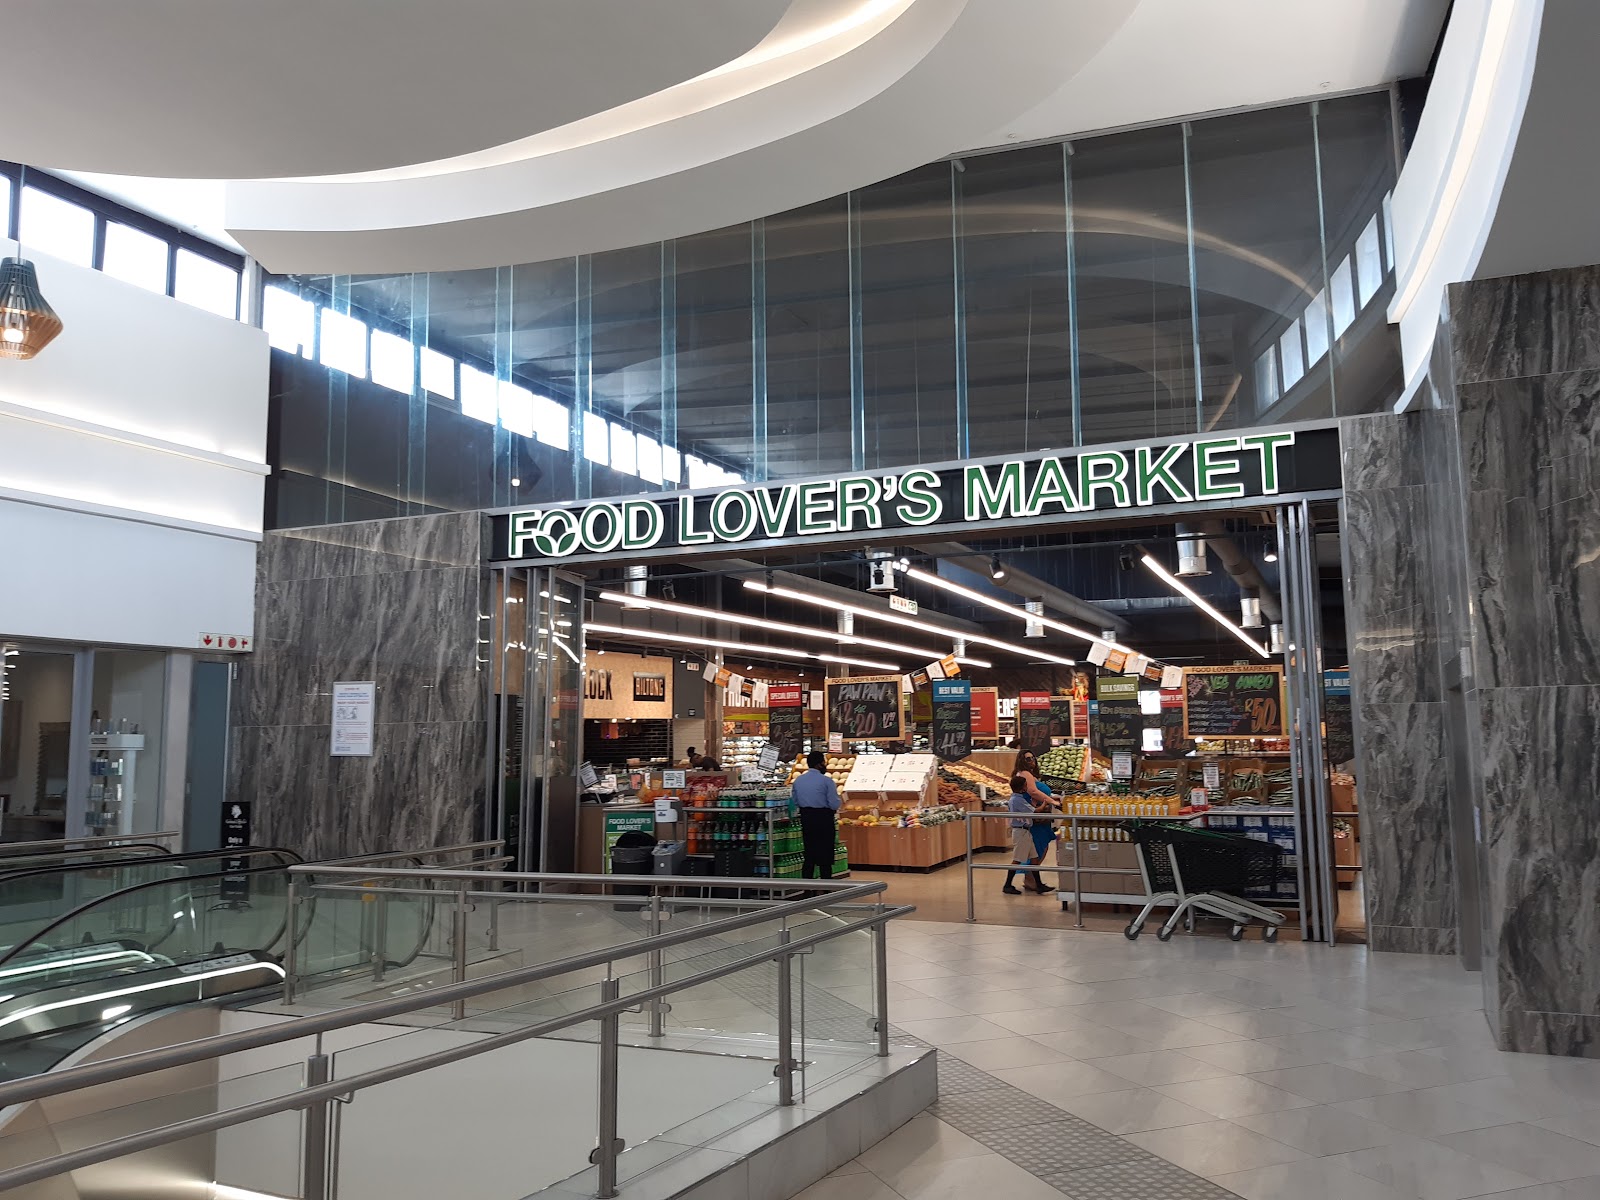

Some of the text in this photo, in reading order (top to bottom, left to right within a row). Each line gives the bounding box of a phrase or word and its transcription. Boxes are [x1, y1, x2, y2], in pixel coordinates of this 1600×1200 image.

[508, 433, 1295, 559] FOOD LOVER'S MARKET
[635, 677, 663, 696] BILTONG
[838, 684, 887, 702] PAW PAW
[951, 686, 965, 694] VALUE
[1101, 684, 1134, 692] BULK SAVINGS
[770, 692, 786, 700] SPECIAL
